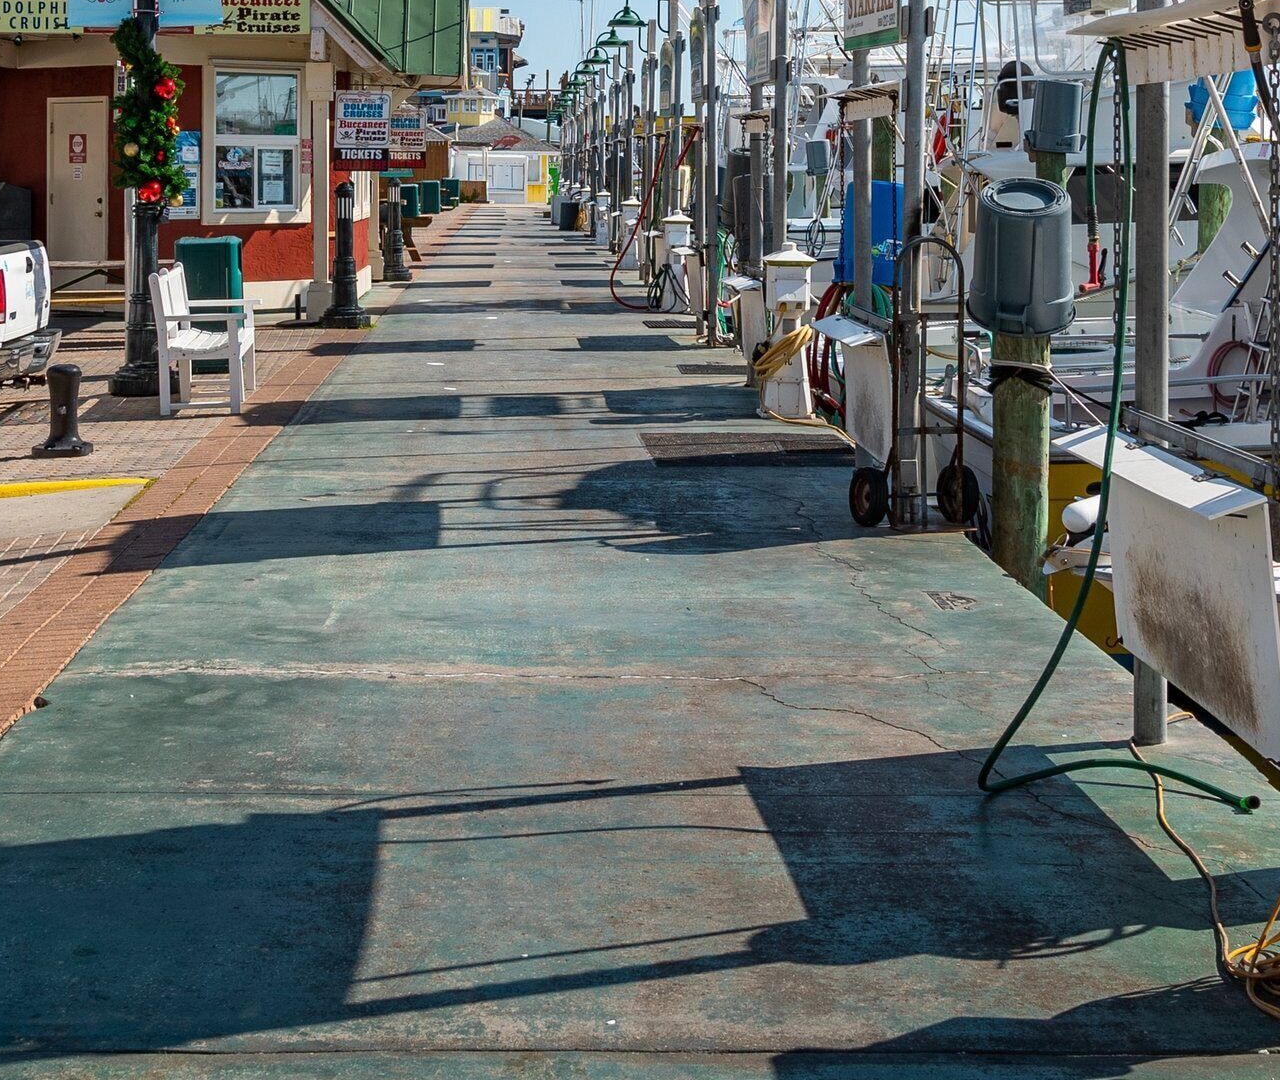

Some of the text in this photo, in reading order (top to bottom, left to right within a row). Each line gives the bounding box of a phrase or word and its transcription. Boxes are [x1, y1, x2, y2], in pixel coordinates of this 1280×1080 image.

[2, 1, 67, 14] DOLPHI
[236, 7, 301, 21] Pirate
[236, 21, 301, 33] Cruises
[338, 120, 388, 129] Buccaneer
[340, 149, 383, 159] TICKETS
[390, 152, 421, 160] TICKETS
